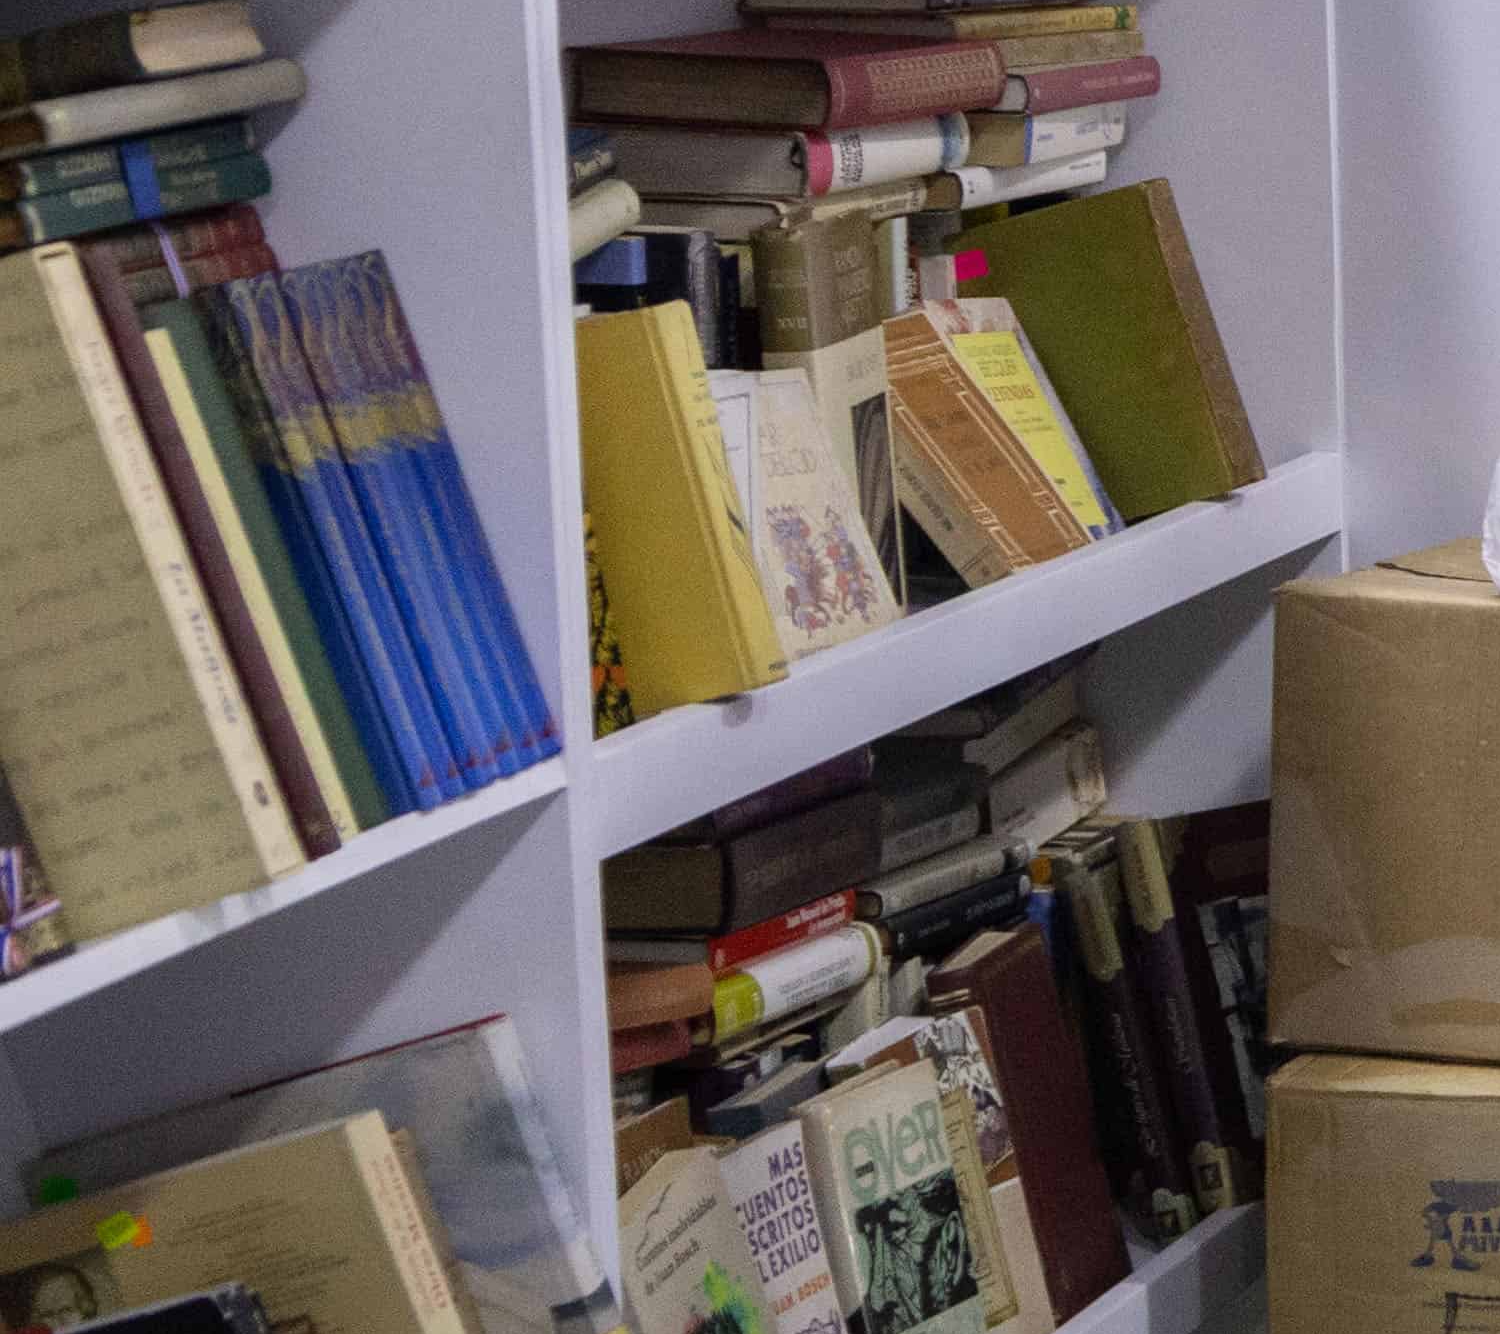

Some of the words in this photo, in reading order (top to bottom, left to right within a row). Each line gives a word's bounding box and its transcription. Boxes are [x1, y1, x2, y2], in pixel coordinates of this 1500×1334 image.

[766, 1139, 804, 1181] MAS
[747, 1199, 816, 1257] SCRITOS
[770, 1227, 821, 1278] EXILIO
